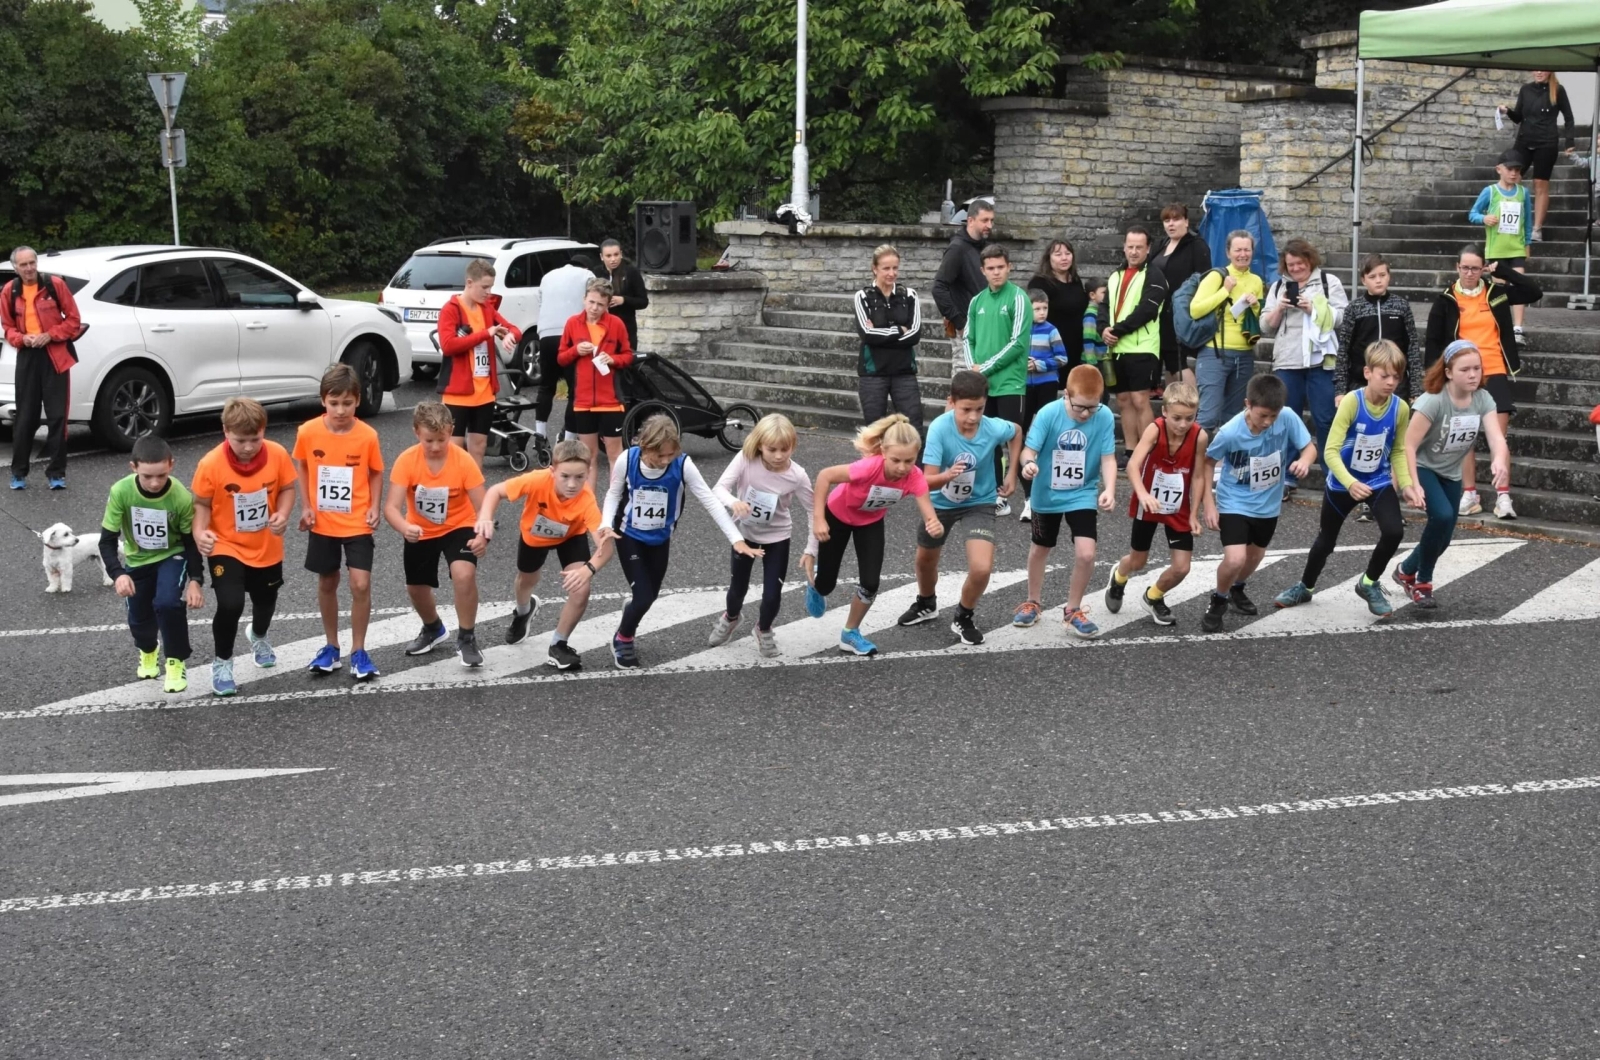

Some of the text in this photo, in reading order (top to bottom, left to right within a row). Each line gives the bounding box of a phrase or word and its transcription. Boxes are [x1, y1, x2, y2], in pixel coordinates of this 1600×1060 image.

[1501, 213, 1520, 224] 107
[409, 310, 422, 319] 5H7
[1449, 431, 1477, 444] 143
[1355, 448, 1383, 462] 139
[1054, 465, 1084, 480] 145
[1252, 466, 1280, 482] 150
[319, 485, 351, 501] 152
[1152, 487, 1182, 503] 117
[236, 503, 268, 522] 127
[416, 501, 445, 514] 121
[634, 506, 666, 519] 144
[746, 502, 771, 521] 51
[134, 523, 167, 538] 105
